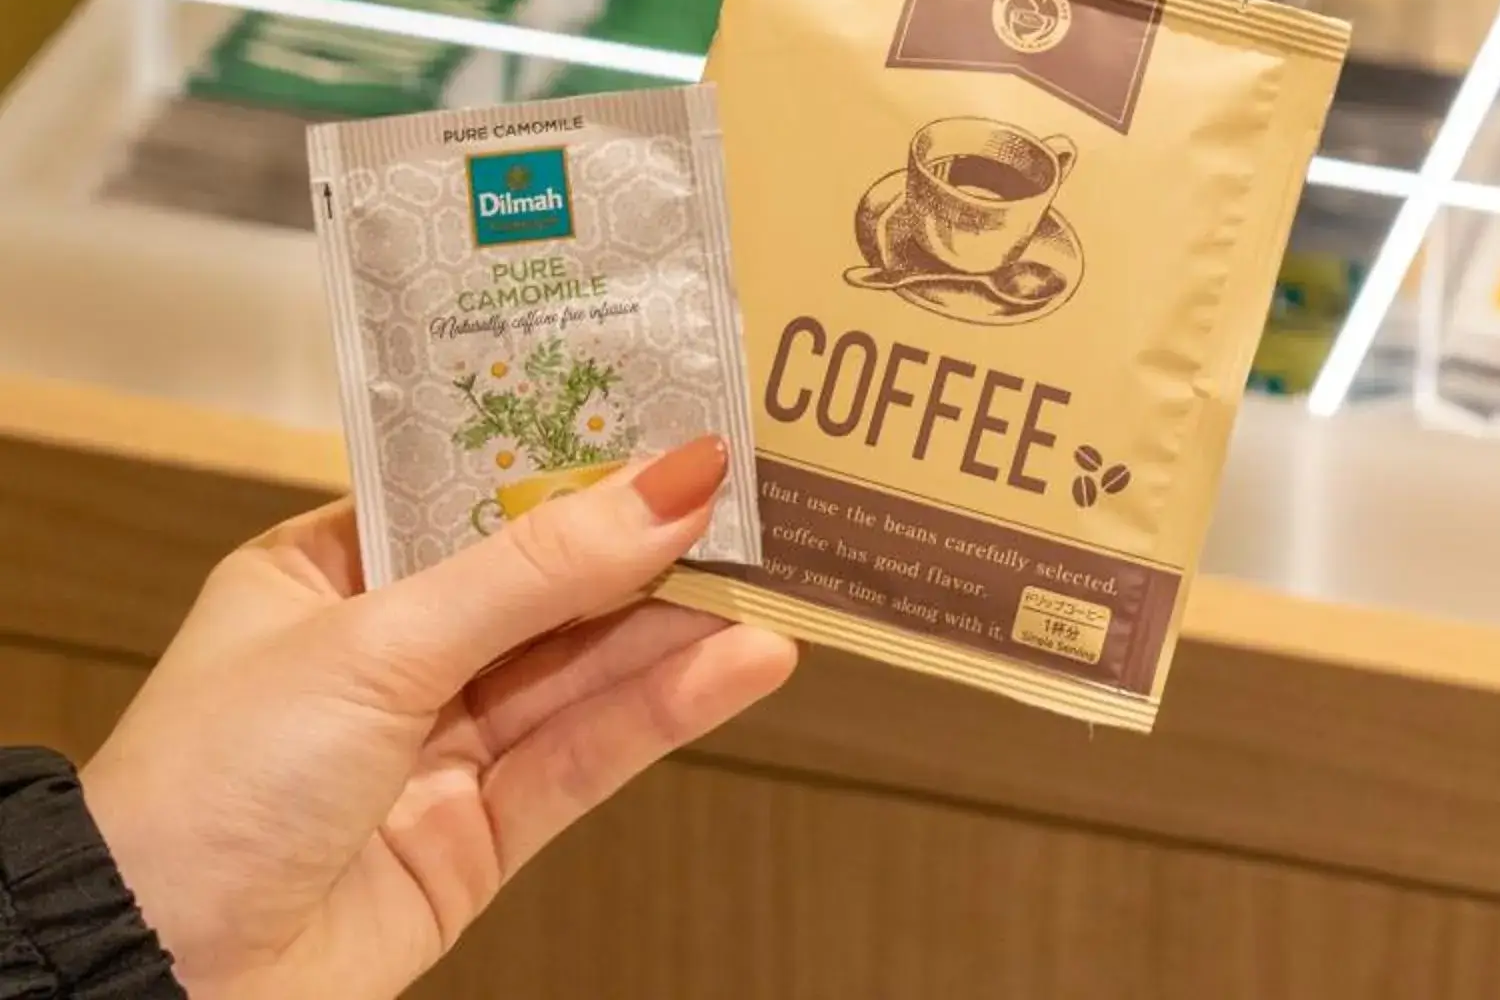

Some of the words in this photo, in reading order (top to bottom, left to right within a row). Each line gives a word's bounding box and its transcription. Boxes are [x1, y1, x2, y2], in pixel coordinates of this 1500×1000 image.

[443, 126, 488, 144] PURE
[493, 115, 586, 139] CAMOMILE
[478, 187, 564, 217] Dilmah
[457, 274, 608, 313] CAMOMILE
[492, 257, 567, 284] PURE
[763, 315, 1072, 496] COFFEE
[762, 481, 800, 504] that
[806, 496, 840, 516] use
[846, 506, 877, 528] the
[883, 513, 938, 545] beans
[944, 535, 1031, 572] carefully
[1035, 560, 1119, 596] selected.
[772, 525, 830, 552] coffee
[835, 538, 868, 563] has
[873, 555, 921, 580] good
[926, 564, 990, 600] flavor.
[761, 557, 798, 580] njoy
[801, 568, 845, 592] your
[848, 581, 888, 606] time
[892, 596, 940, 624] along
[945, 609, 983, 636] with
